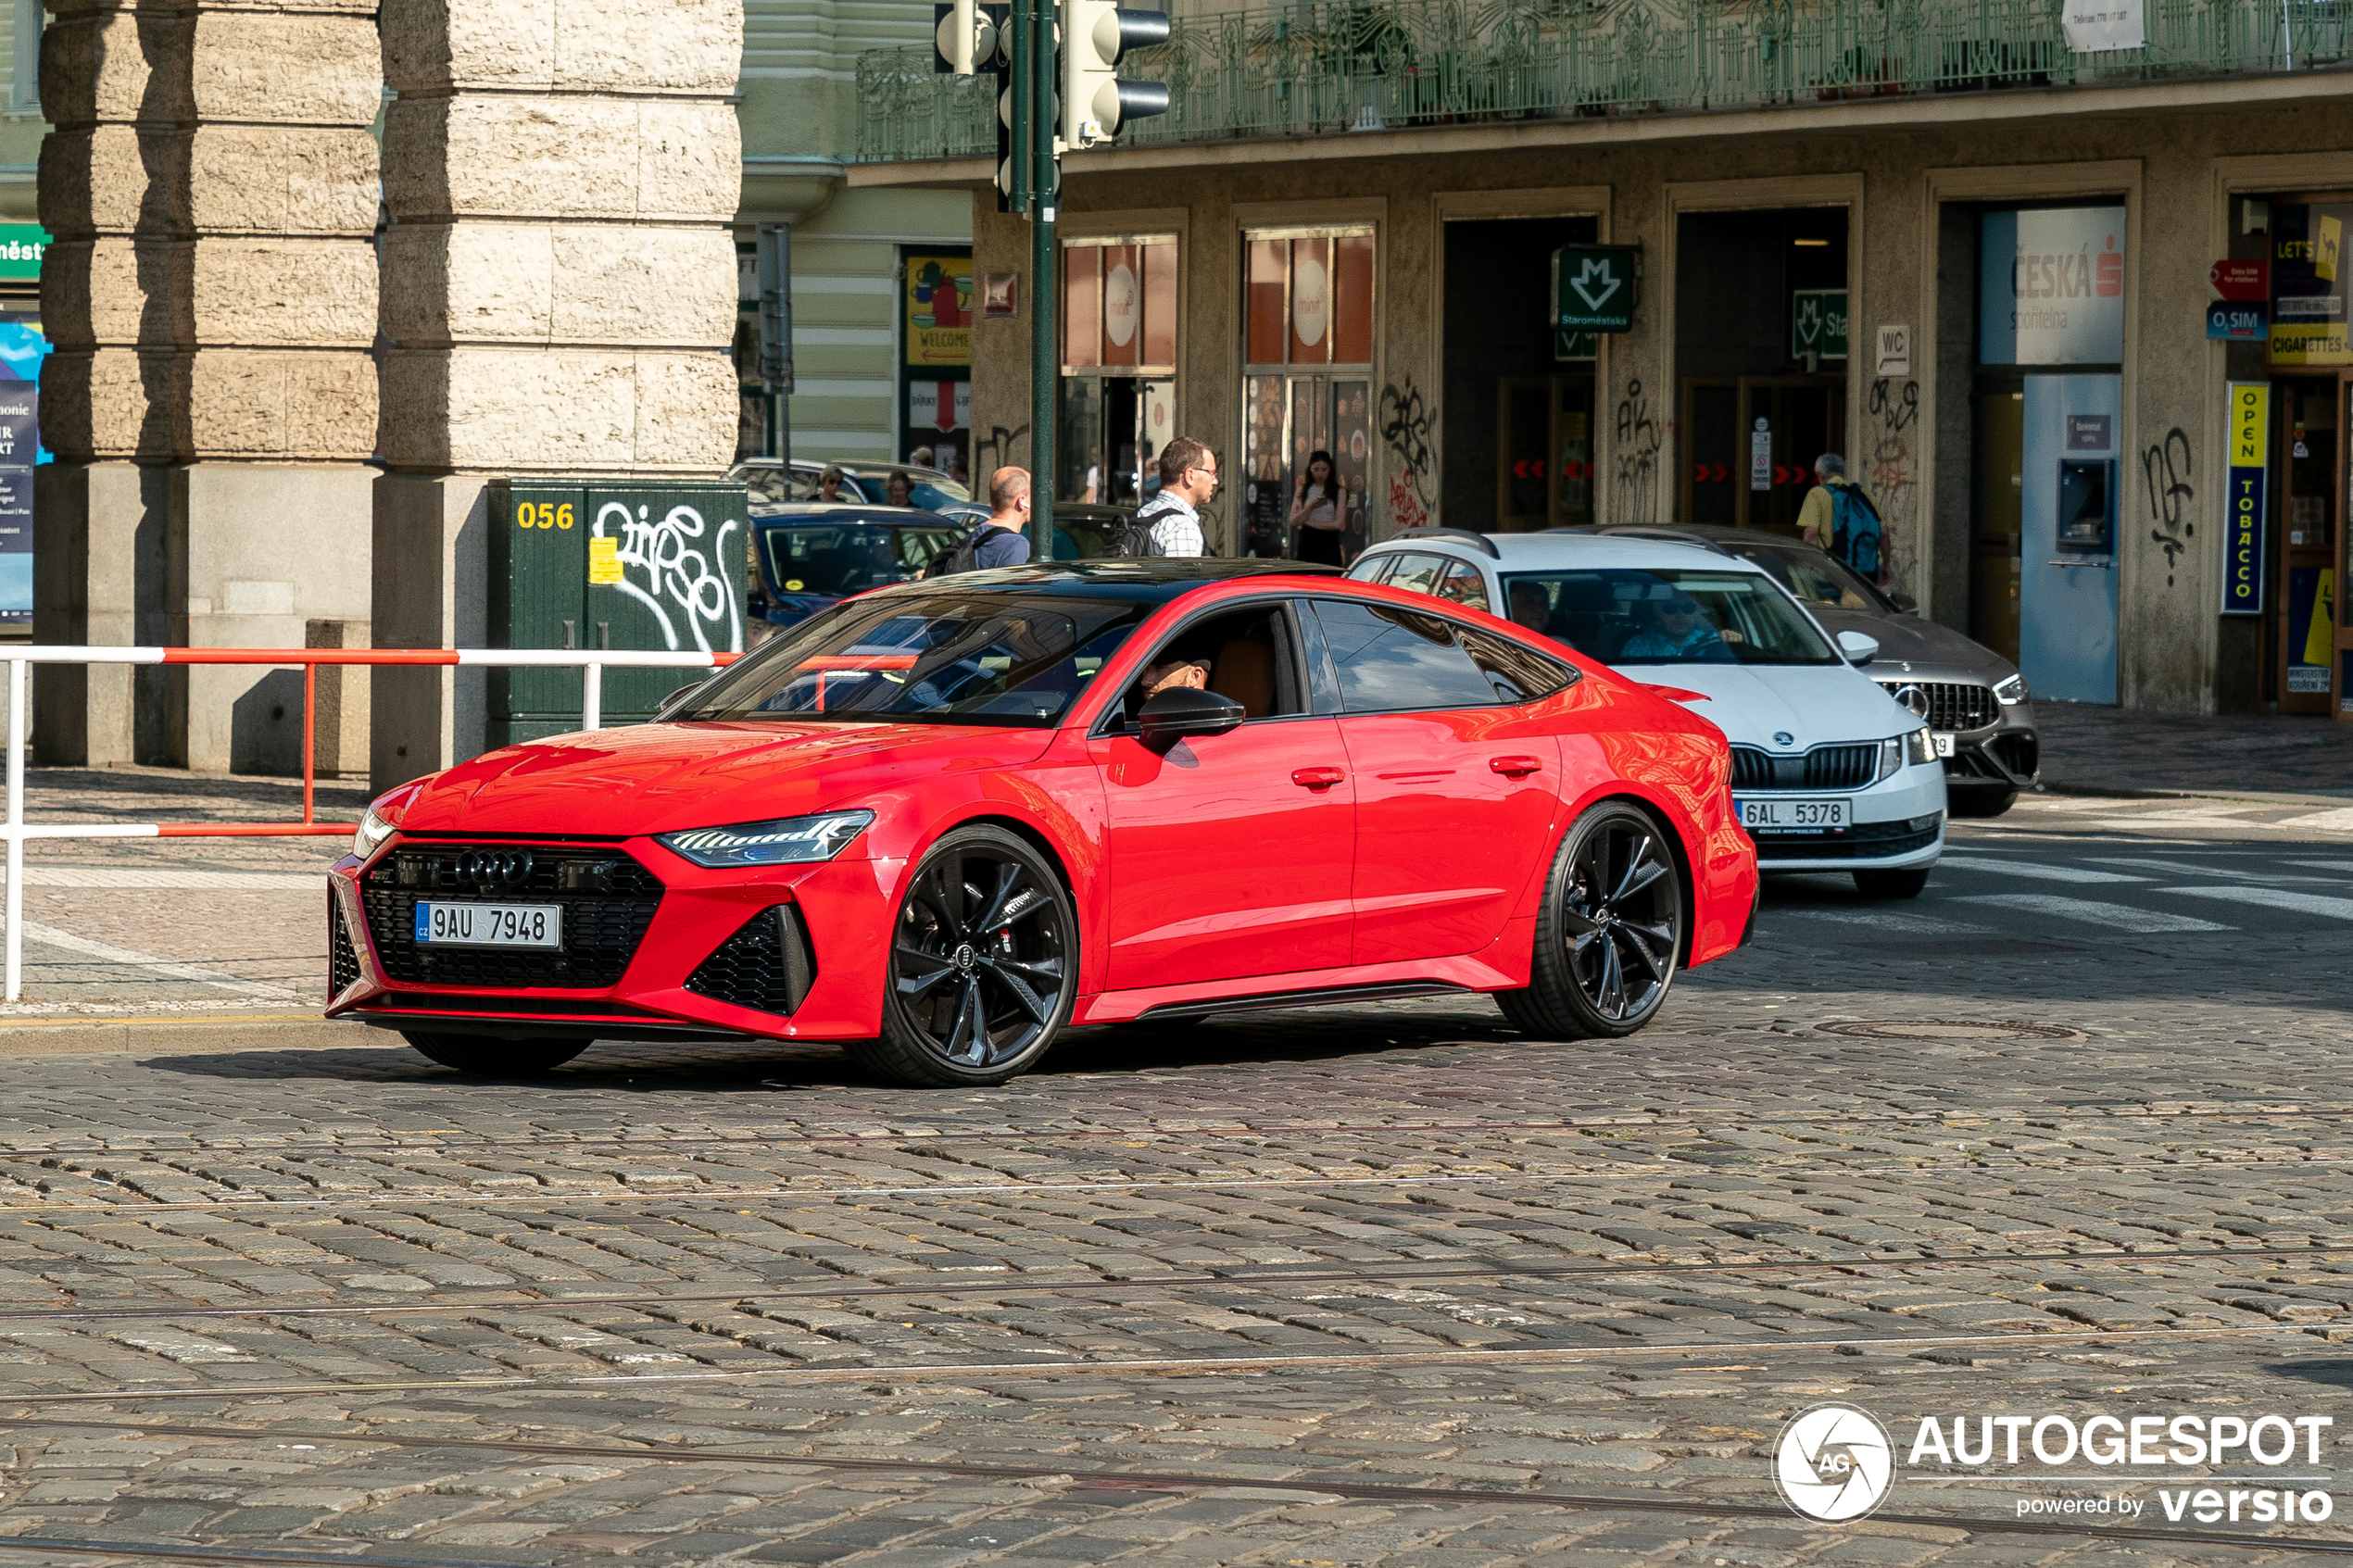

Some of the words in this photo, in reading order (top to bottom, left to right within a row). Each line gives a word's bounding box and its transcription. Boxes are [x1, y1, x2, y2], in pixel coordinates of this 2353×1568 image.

[2278, 242, 2313, 258] LET'S
[2011, 243, 2092, 298] ČESKÁ
[1562, 314, 1627, 325] Staroměstská
[2010, 307, 2068, 330] spořitelna
[2230, 311, 2258, 328] SIM
[920, 333, 969, 347] WELCOME
[1882, 332, 1904, 352] WC
[2272, 336, 2342, 354] CIGARETTES
[2241, 393, 2257, 458] OPEN
[518, 502, 573, 530] 056
[2235, 480, 2254, 597] TOBACCO
[1746, 804, 1780, 823] 6AL
[1795, 804, 1842, 823] 5378
[418, 927, 428, 936] CZ
[434, 909, 472, 938] 9AU
[491, 910, 546, 940] 7948
